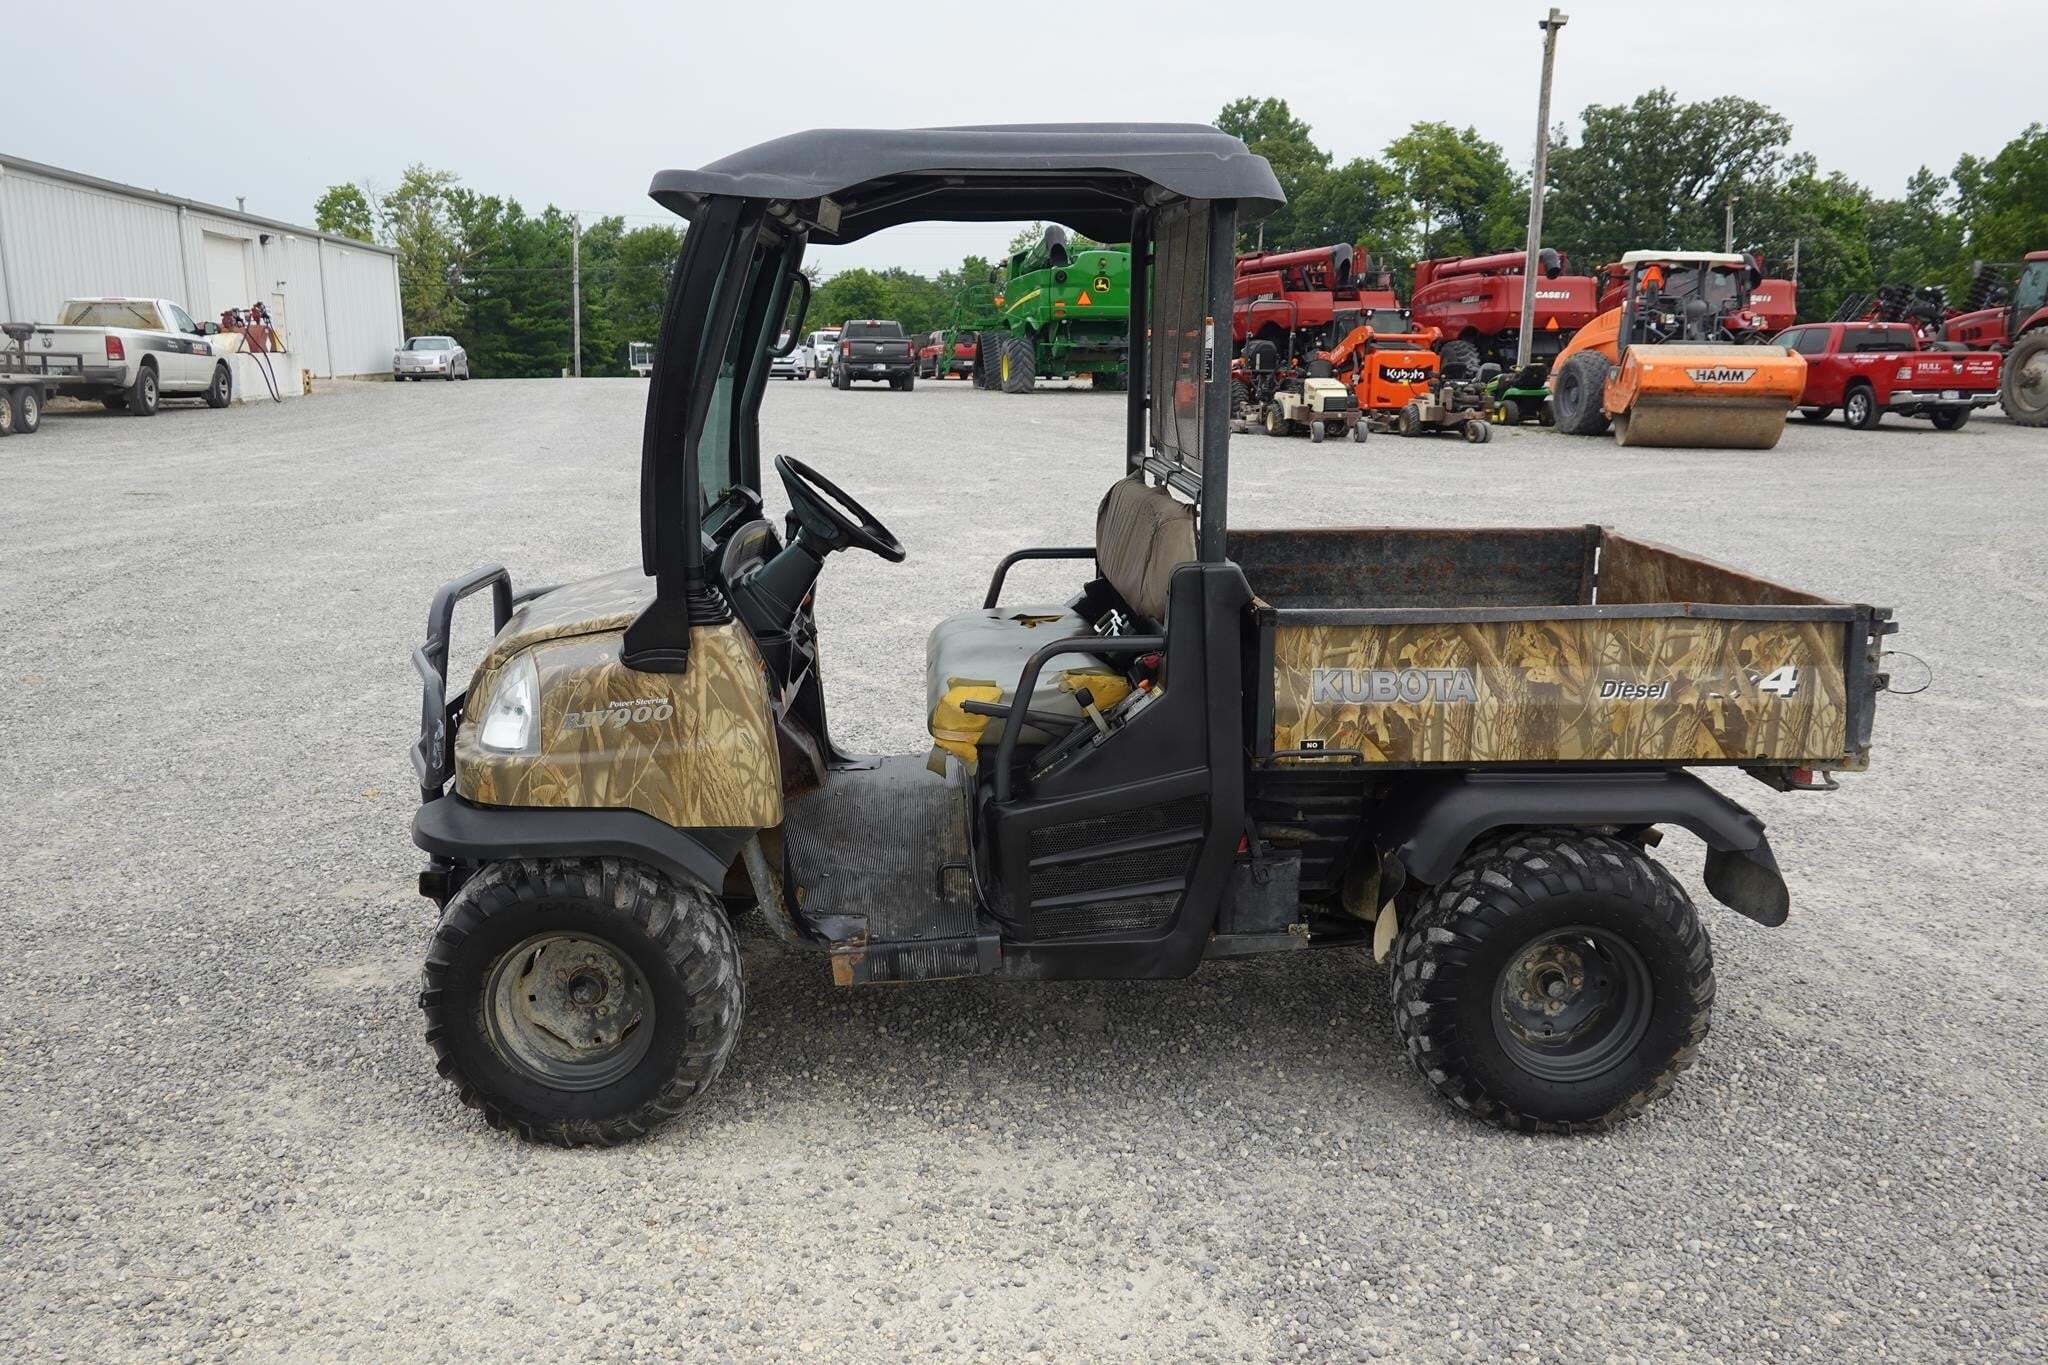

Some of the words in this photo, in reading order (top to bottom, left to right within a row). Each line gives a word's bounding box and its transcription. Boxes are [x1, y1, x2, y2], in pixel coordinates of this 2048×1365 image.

[1386, 368, 1425, 379] Kubota
[1696, 369, 1744, 381] HAMM
[1311, 668, 1481, 704] KUBOTA
[1600, 679, 1671, 700] Diesel
[609, 700, 634, 708] Power
[635, 697, 668, 706] Steering
